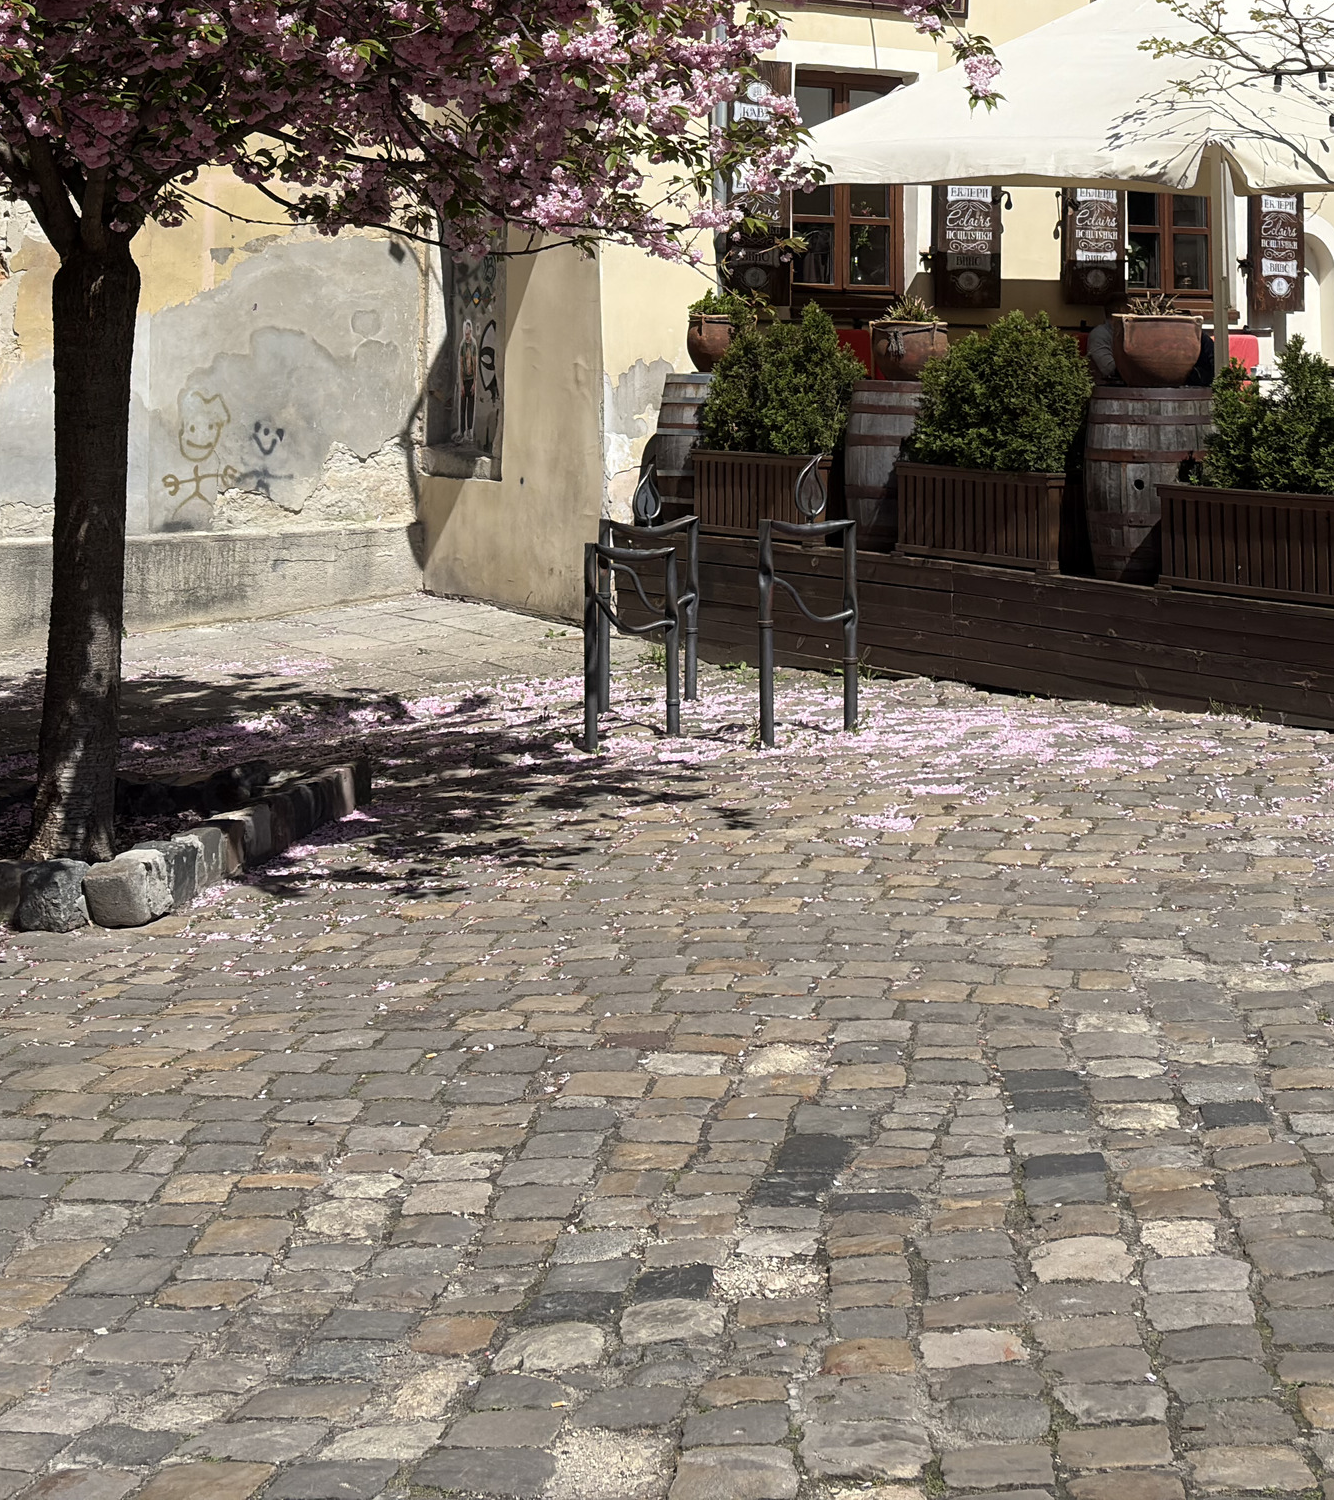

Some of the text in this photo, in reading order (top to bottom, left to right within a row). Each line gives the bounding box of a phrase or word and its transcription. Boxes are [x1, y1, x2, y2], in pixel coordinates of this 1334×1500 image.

[950, 187, 989, 199] ЕКЛЕРИ
[946, 209, 992, 228] Eclairs
[1076, 209, 1118, 227] Eclairs
[1261, 220, 1298, 237] Eclairs
